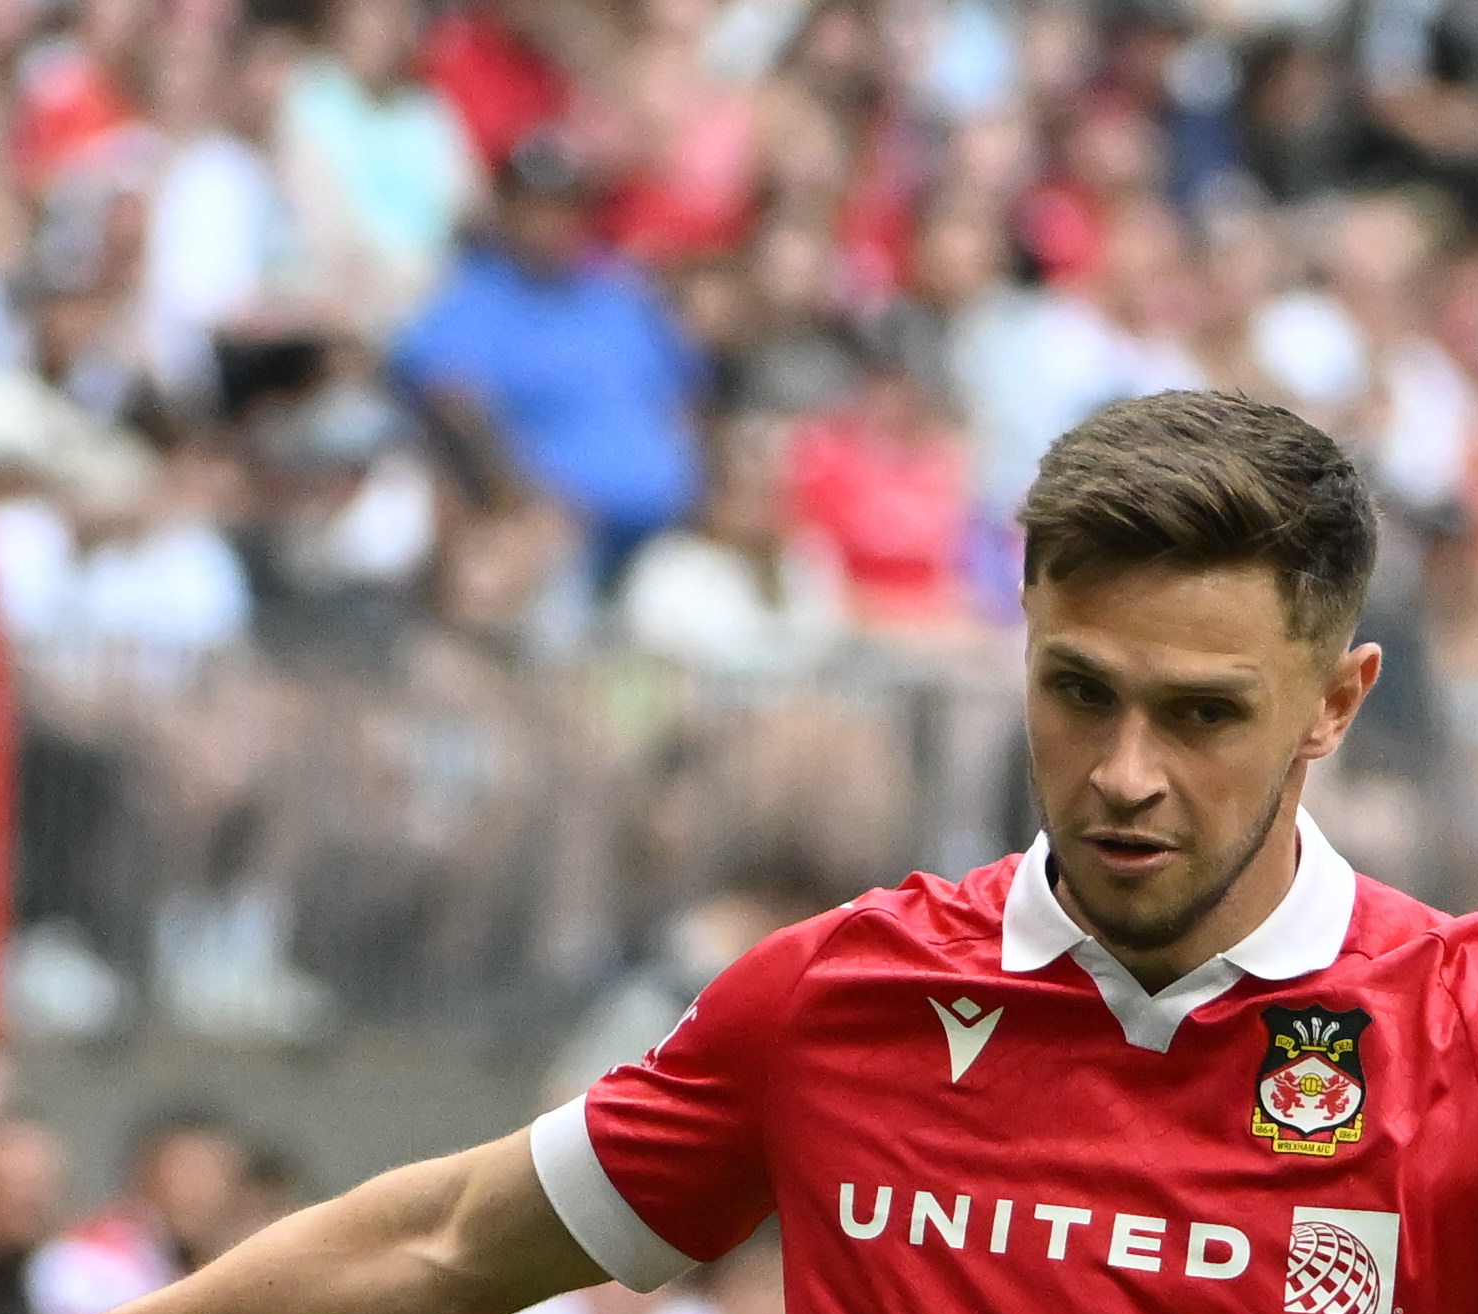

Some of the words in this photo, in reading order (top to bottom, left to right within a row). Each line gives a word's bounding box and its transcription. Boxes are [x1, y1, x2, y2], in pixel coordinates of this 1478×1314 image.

[1277, 1142, 1315, 1152] WREXHAM
[1315, 1143, 1331, 1154] AFC
[838, 1182, 1252, 1280] UNITED
